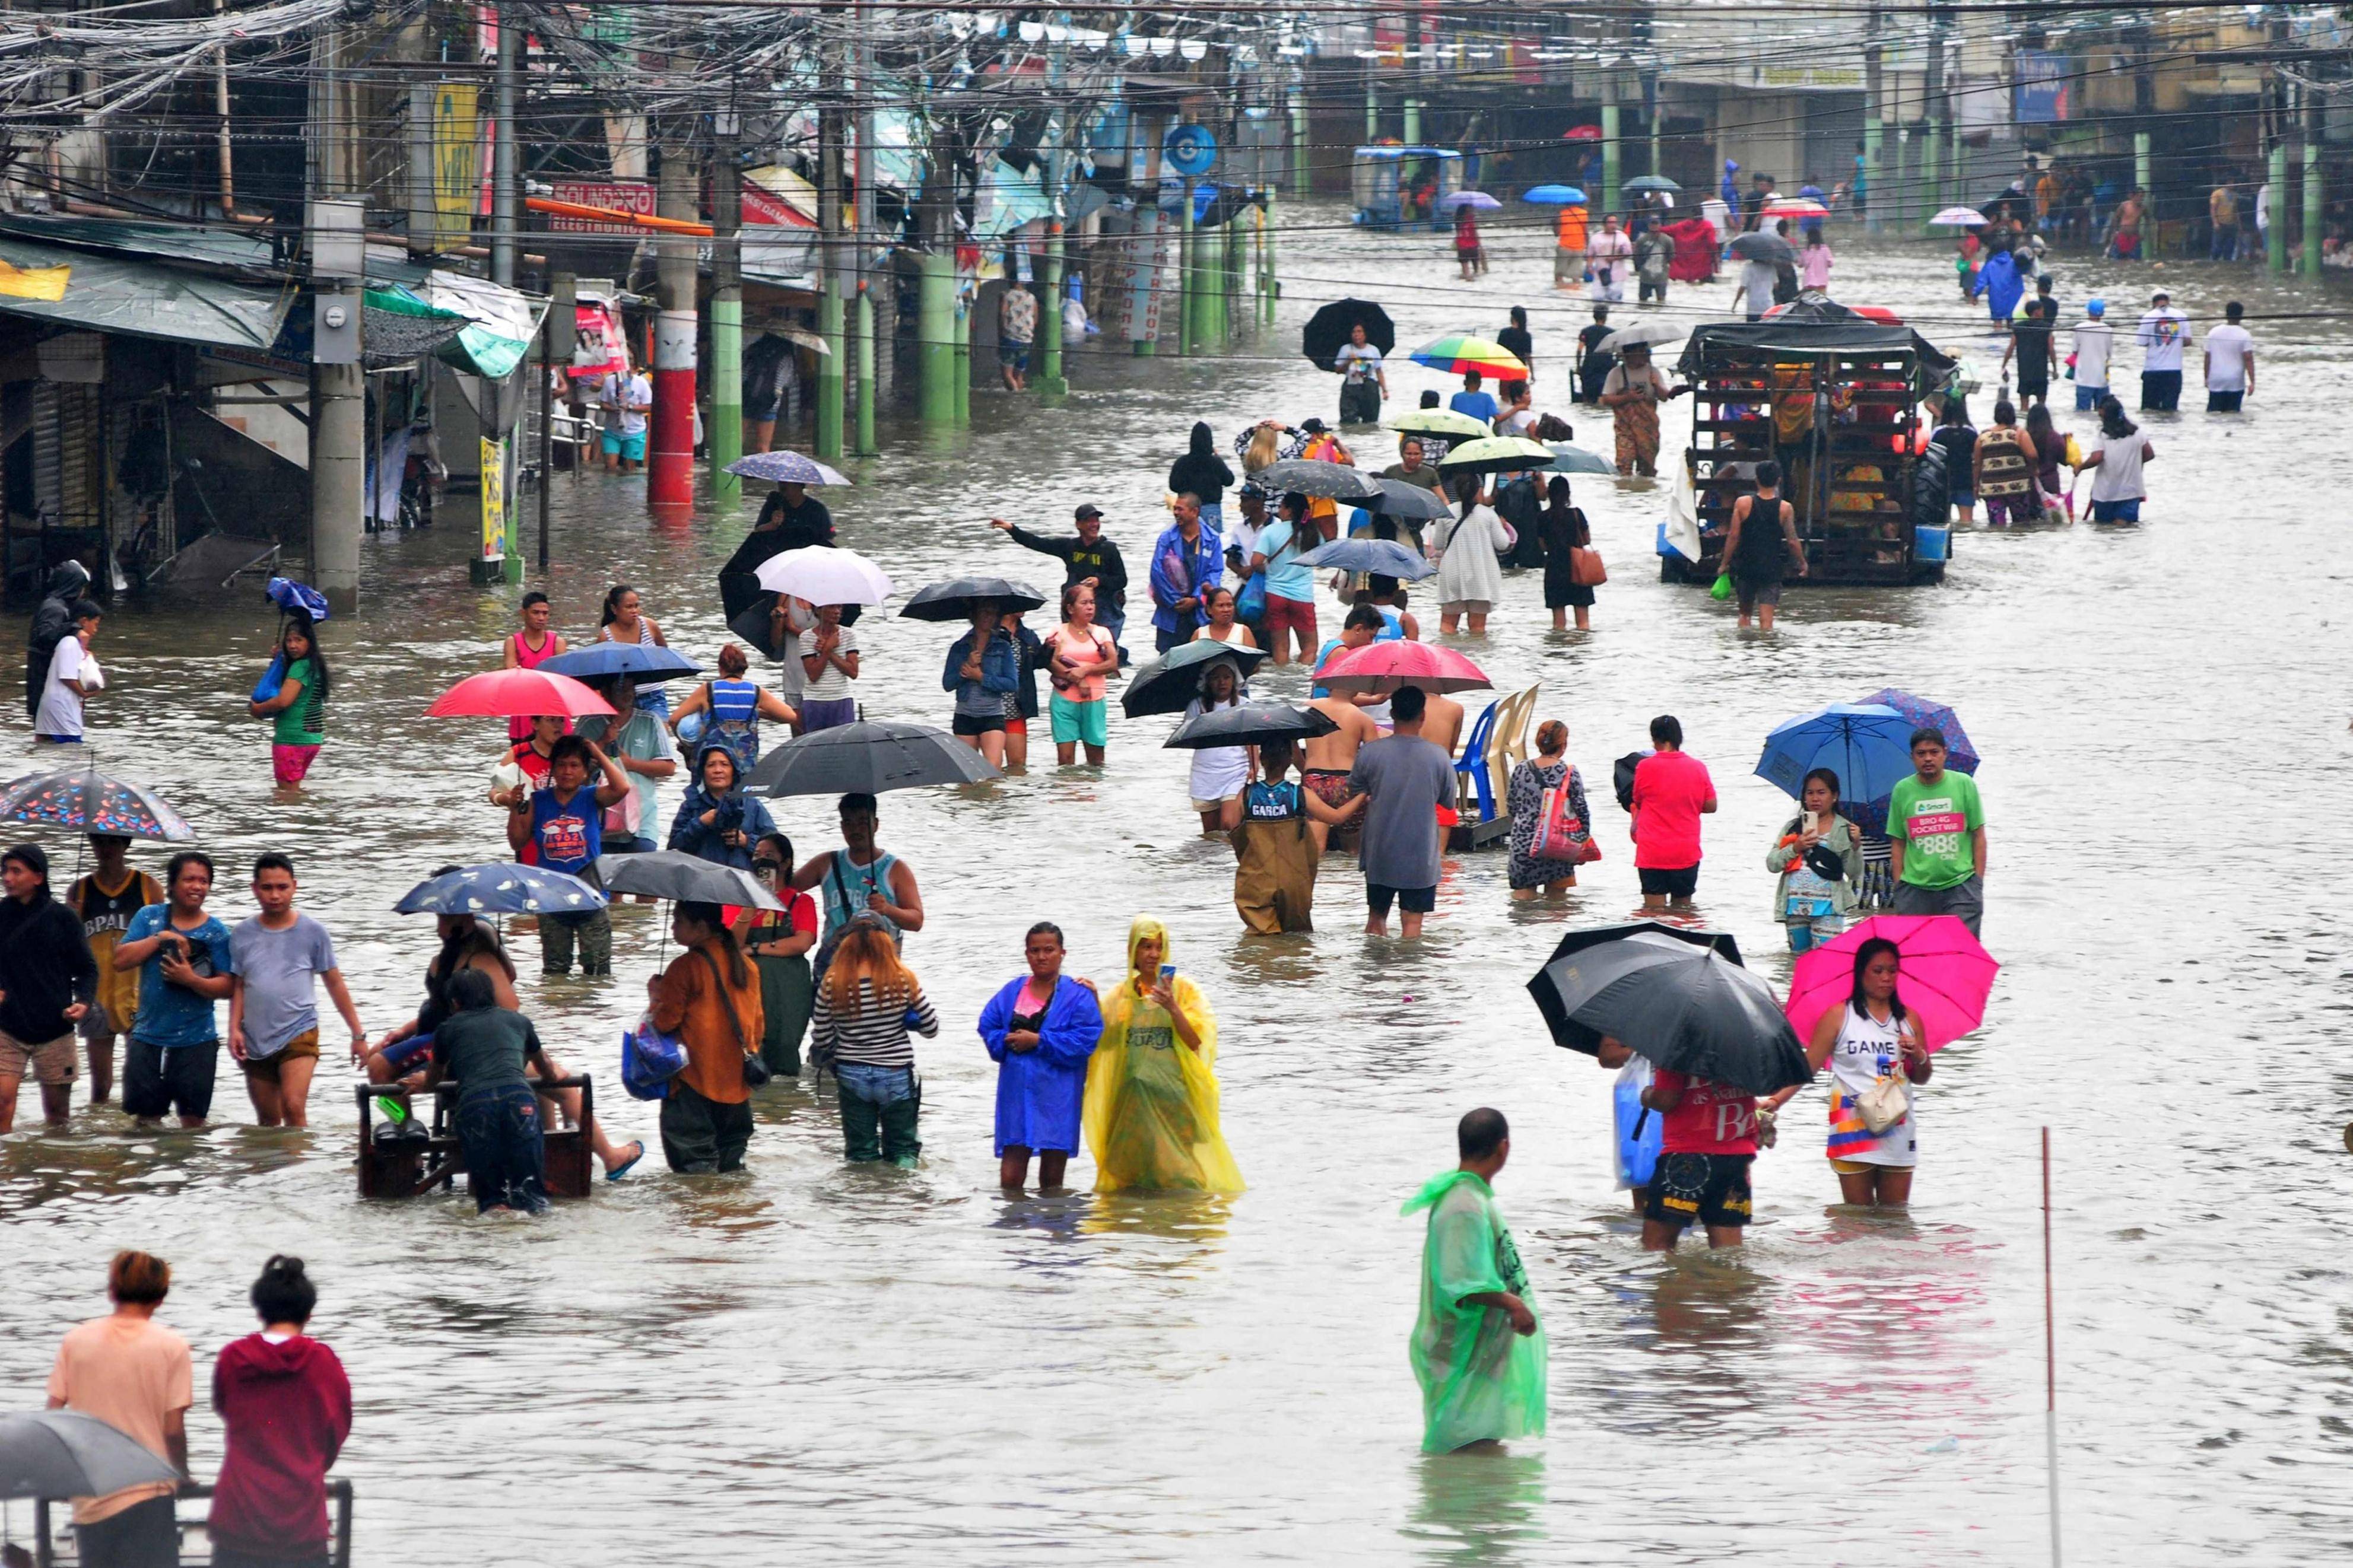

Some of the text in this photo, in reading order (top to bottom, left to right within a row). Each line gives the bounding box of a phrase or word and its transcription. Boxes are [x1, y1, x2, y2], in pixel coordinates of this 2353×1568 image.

[554, 185, 650, 213] SOUNDPRO
[552, 217, 647, 234] ELECTRONICS
[1919, 817, 1938, 826] BRO
[1911, 823, 1942, 835] POCKET
[548, 832, 579, 842] 1962
[1847, 1040, 1895, 1055] GAME
